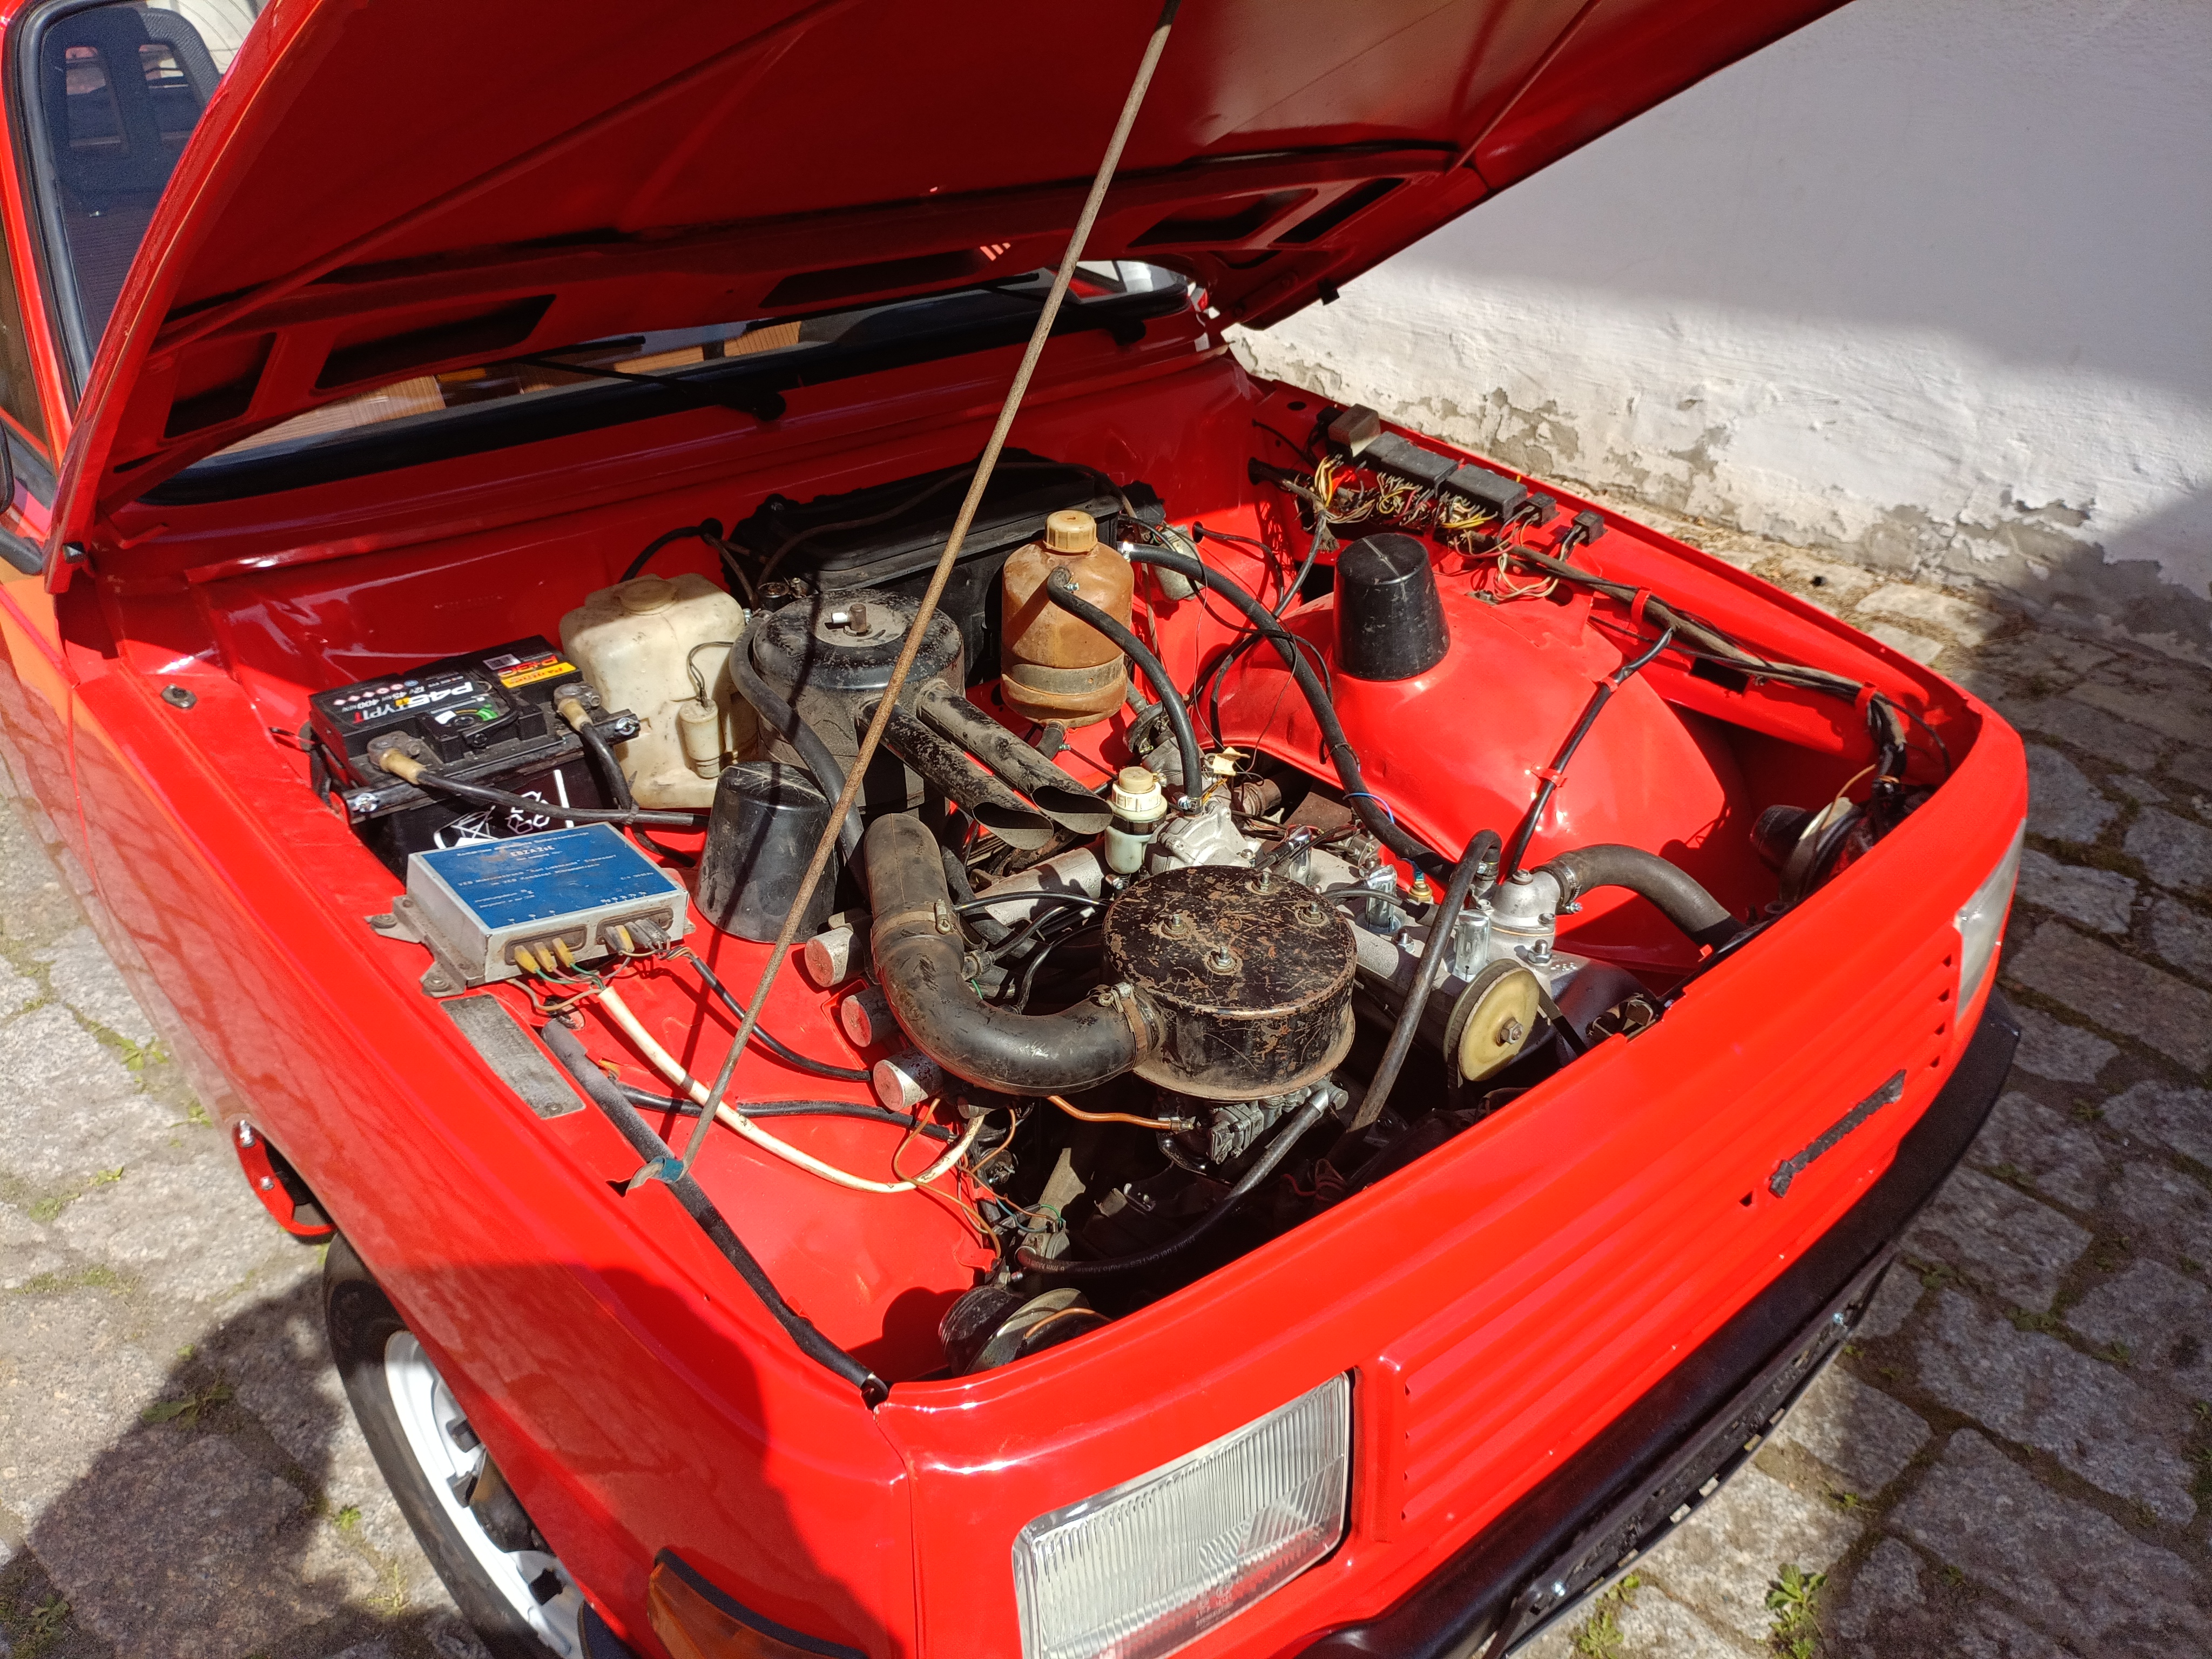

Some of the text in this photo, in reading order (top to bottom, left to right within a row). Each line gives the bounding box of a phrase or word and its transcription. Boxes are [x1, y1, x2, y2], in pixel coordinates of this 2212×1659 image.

[1161, 1245, 1178, 1258] Fuel
[1047, 1264, 1058, 1272] mm
[1103, 1264, 1121, 1272] Auto
